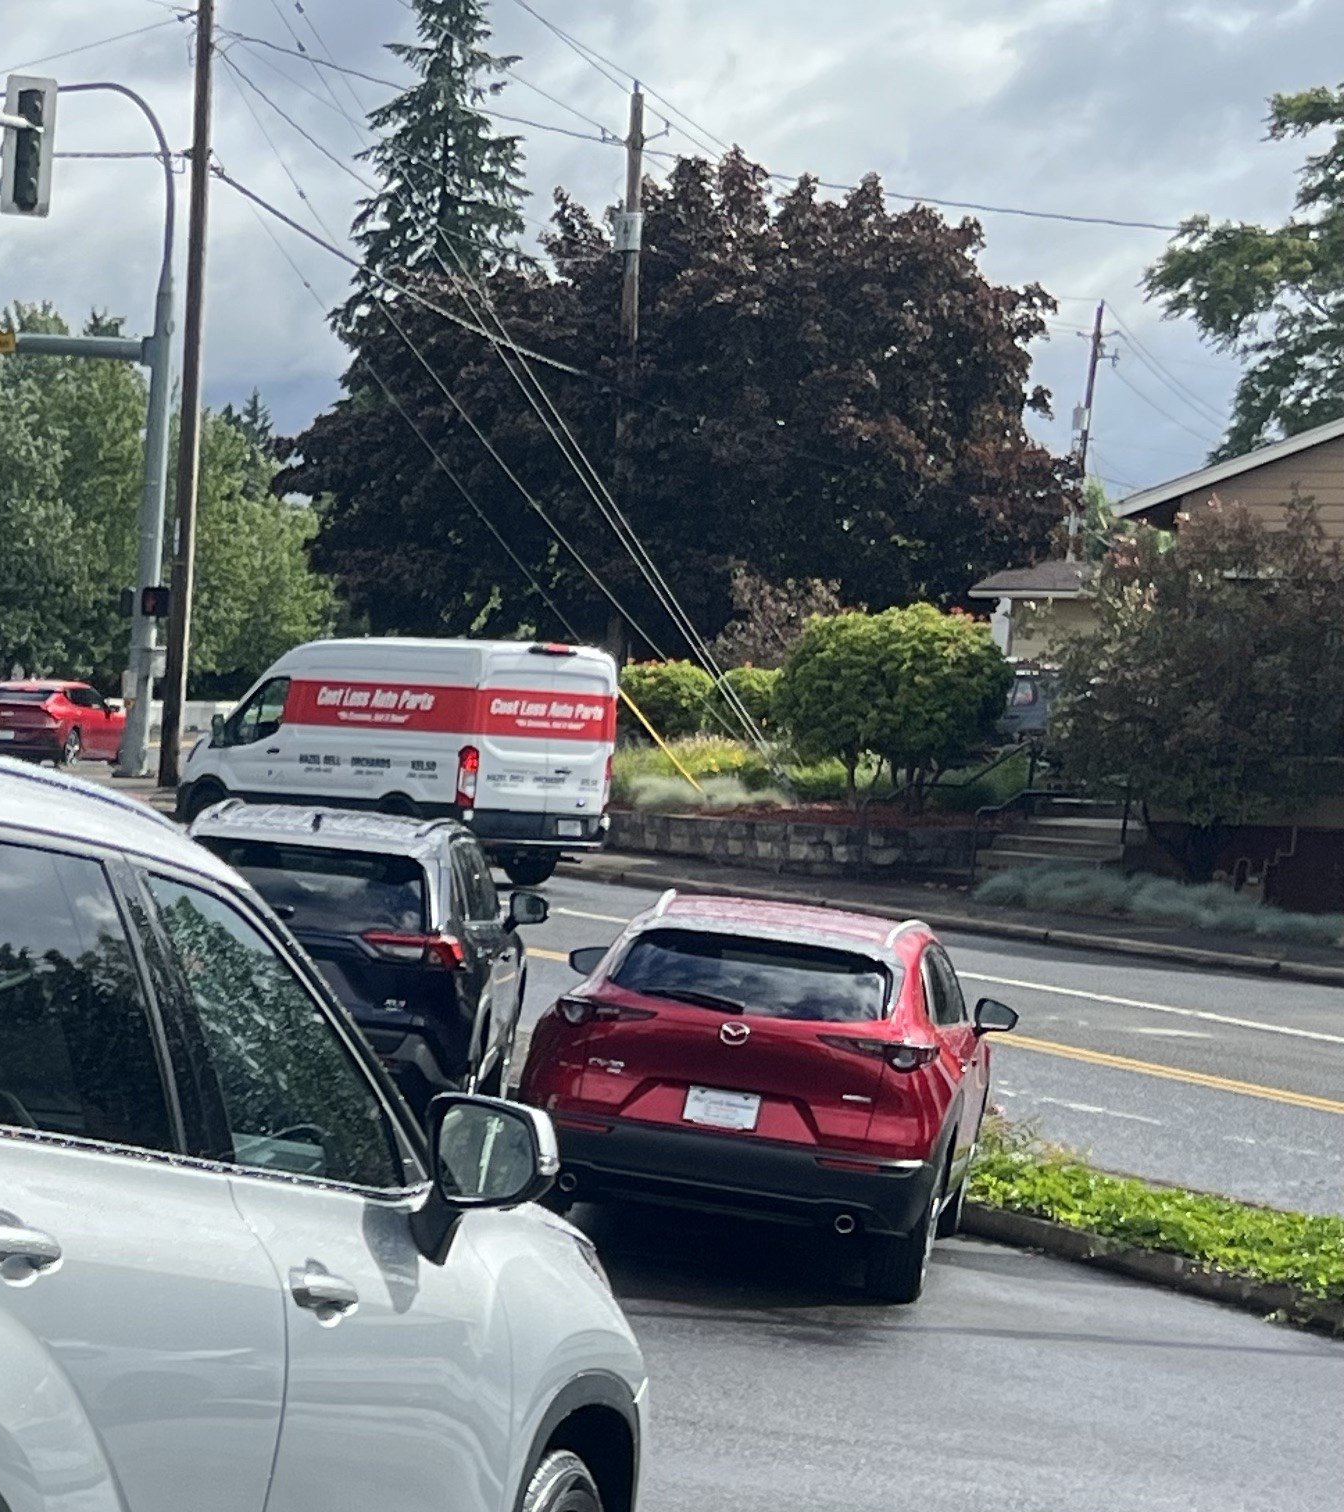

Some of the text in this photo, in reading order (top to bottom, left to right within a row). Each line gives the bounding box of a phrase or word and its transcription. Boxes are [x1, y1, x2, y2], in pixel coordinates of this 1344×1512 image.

[370, 688, 399, 709] Auto
[398, 690, 436, 711] Parts
[574, 703, 604, 721] Parts
